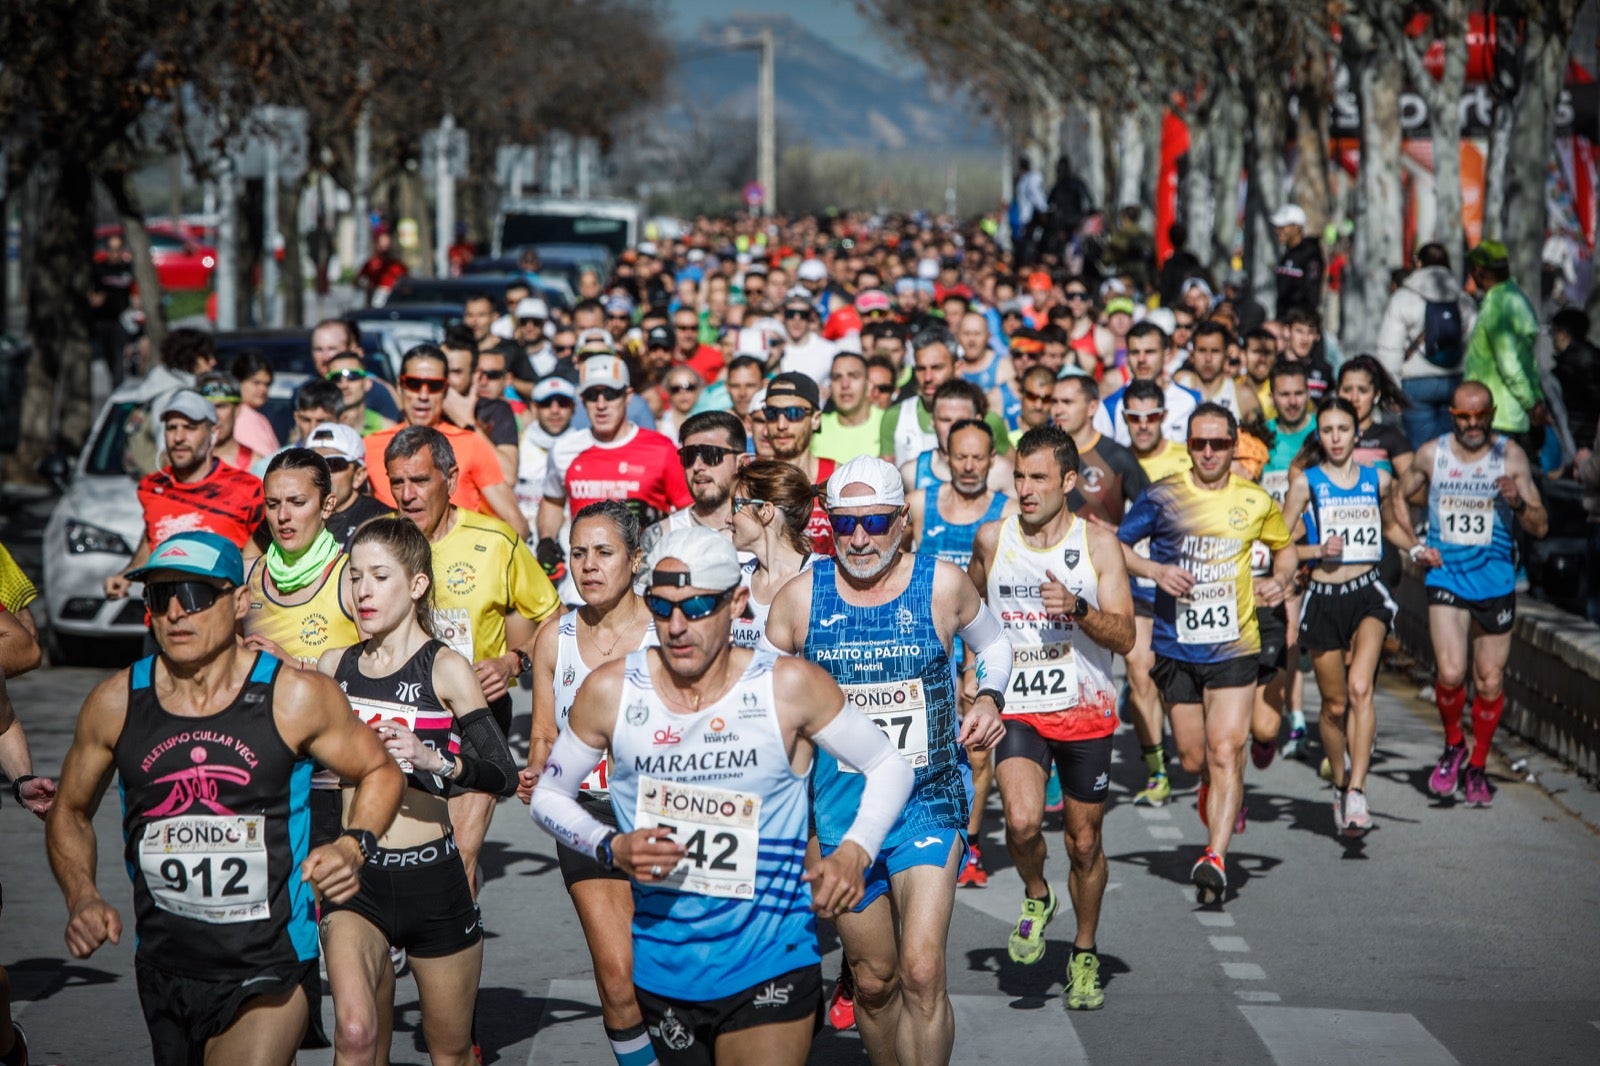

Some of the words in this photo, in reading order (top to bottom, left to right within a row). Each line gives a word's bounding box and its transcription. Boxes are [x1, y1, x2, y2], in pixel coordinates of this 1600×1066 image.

[1449, 497, 1485, 509] FONDO
[1334, 509, 1370, 520] FONDO
[1446, 514, 1486, 534] 133
[446, 562, 477, 573] ATLETISMO
[999, 575, 1083, 585] clinca
[1340, 568, 1381, 596] ARMO
[1190, 588, 1225, 601] ONDO
[301, 613, 329, 625] ATLETISMO
[1185, 605, 1230, 631] 843
[817, 648, 861, 661] PAZITO
[864, 651, 872, 659] a
[875, 645, 920, 659] PAZITO
[1013, 650, 1060, 663] FONDO
[854, 662, 884, 672] Motril
[1012, 668, 1067, 697] 442
[848, 690, 906, 707] FONDO
[141, 732, 191, 773] ATLETISMO
[192, 730, 233, 747] CULLAR
[234, 738, 259, 769] VEGA
[635, 749, 758, 773] MARACENA
[689, 771, 744, 783] ATLETISMO
[664, 791, 736, 817] FONDO
[167, 827, 241, 844] FONDO
[382, 846, 438, 867] PRO
[160, 857, 249, 898] 912
